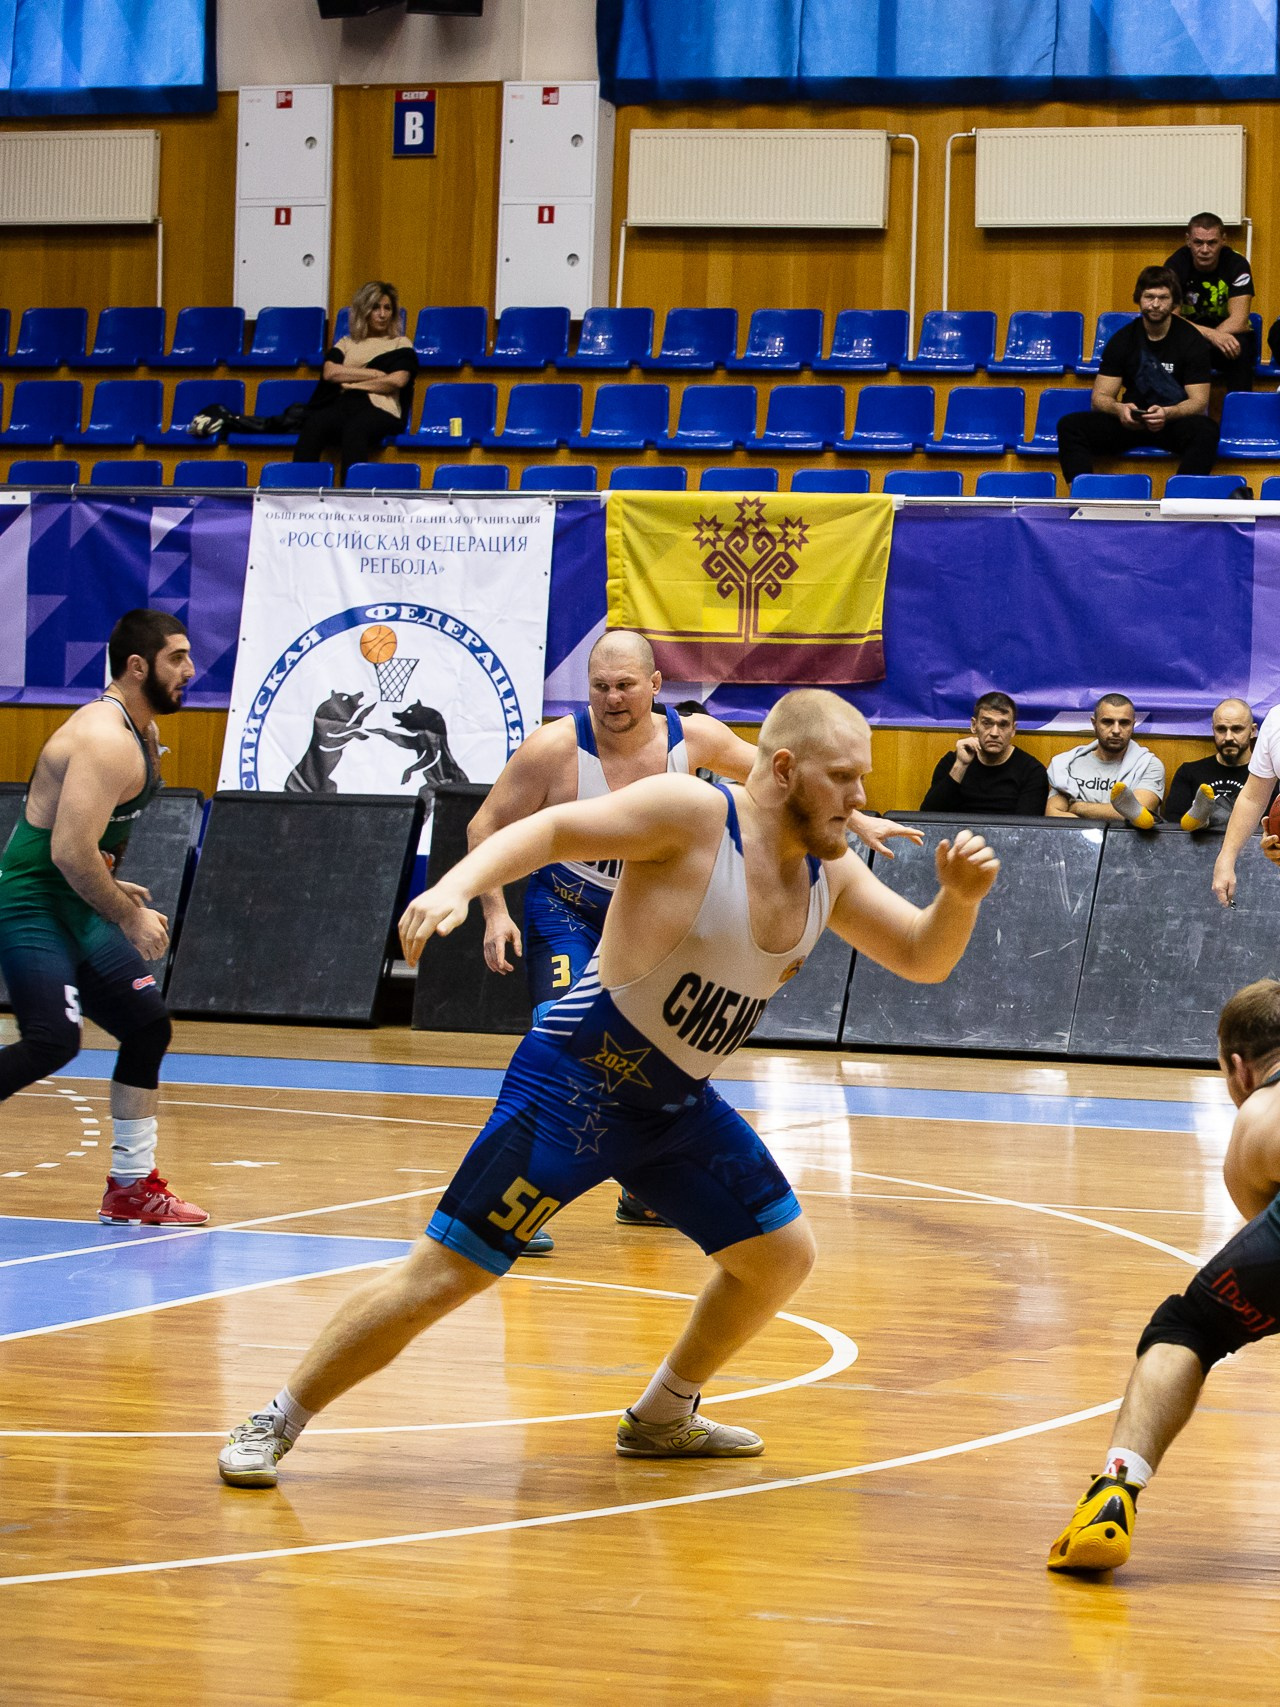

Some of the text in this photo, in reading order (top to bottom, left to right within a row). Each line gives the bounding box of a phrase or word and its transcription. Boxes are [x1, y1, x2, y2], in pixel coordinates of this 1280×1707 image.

[265, 511, 541, 525] ОБЩЕРОССИЙСКАЯ ОБЩЕСТВЕННАЯ ОРГАНИЗАЦИЯ
[280, 530, 528, 554] «РОССИЙСКАЯ ФЕДЕРАЦИЯ
[360, 557, 445, 575] РЕГБОЛА»
[365, 604, 523, 749] ФЕДЕРАЦИЯ
[551, 954, 571, 988] 3
[594, 1047, 636, 1079] 2022
[487, 1176, 561, 1243] 50
